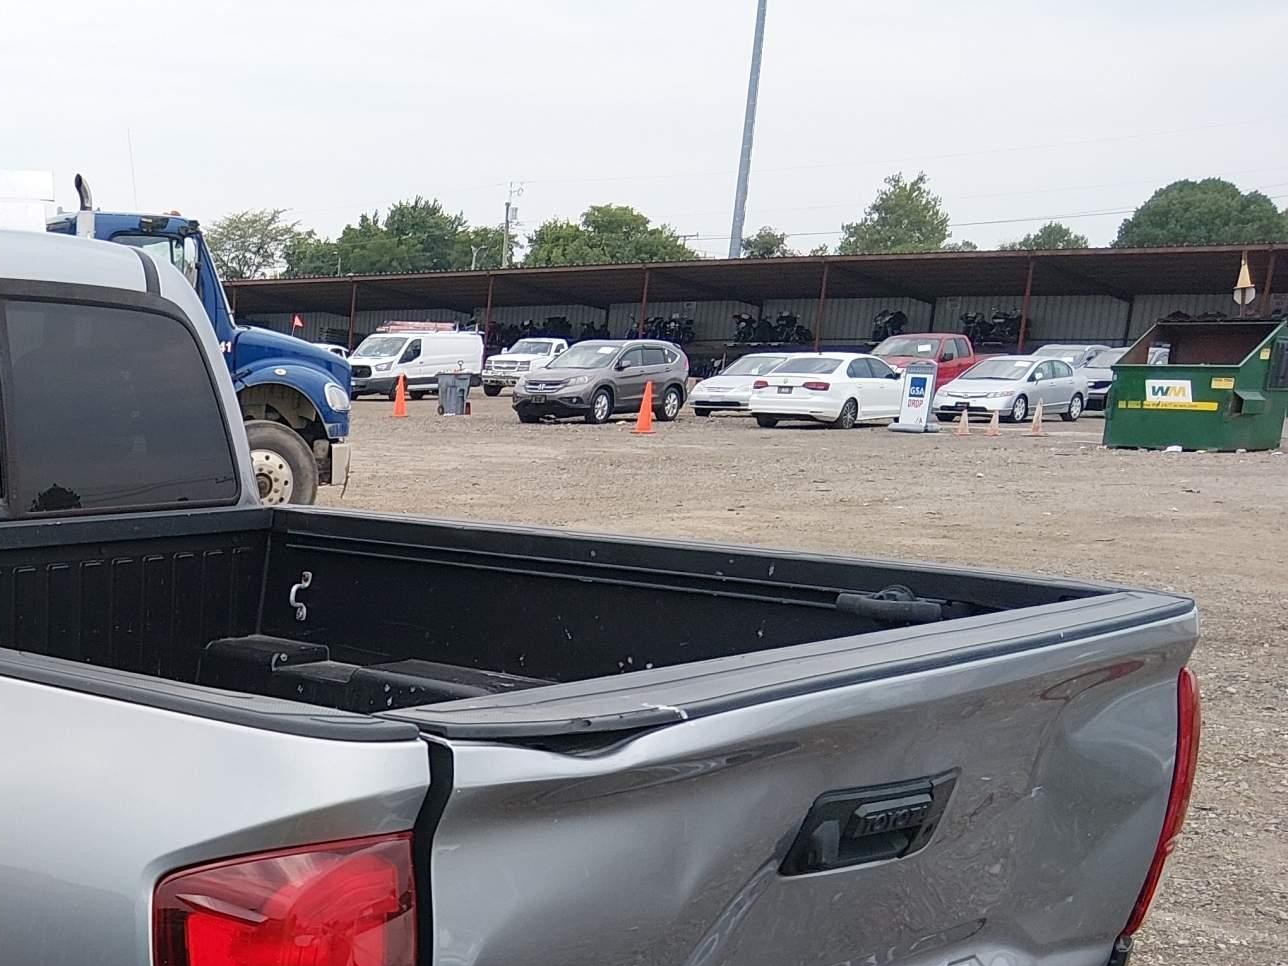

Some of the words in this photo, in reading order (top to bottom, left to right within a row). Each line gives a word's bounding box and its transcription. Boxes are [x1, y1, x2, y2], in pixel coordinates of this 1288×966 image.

[910, 387, 925, 396] GSA
[1151, 385, 1186, 397] WM
[907, 399, 924, 408] DROP
